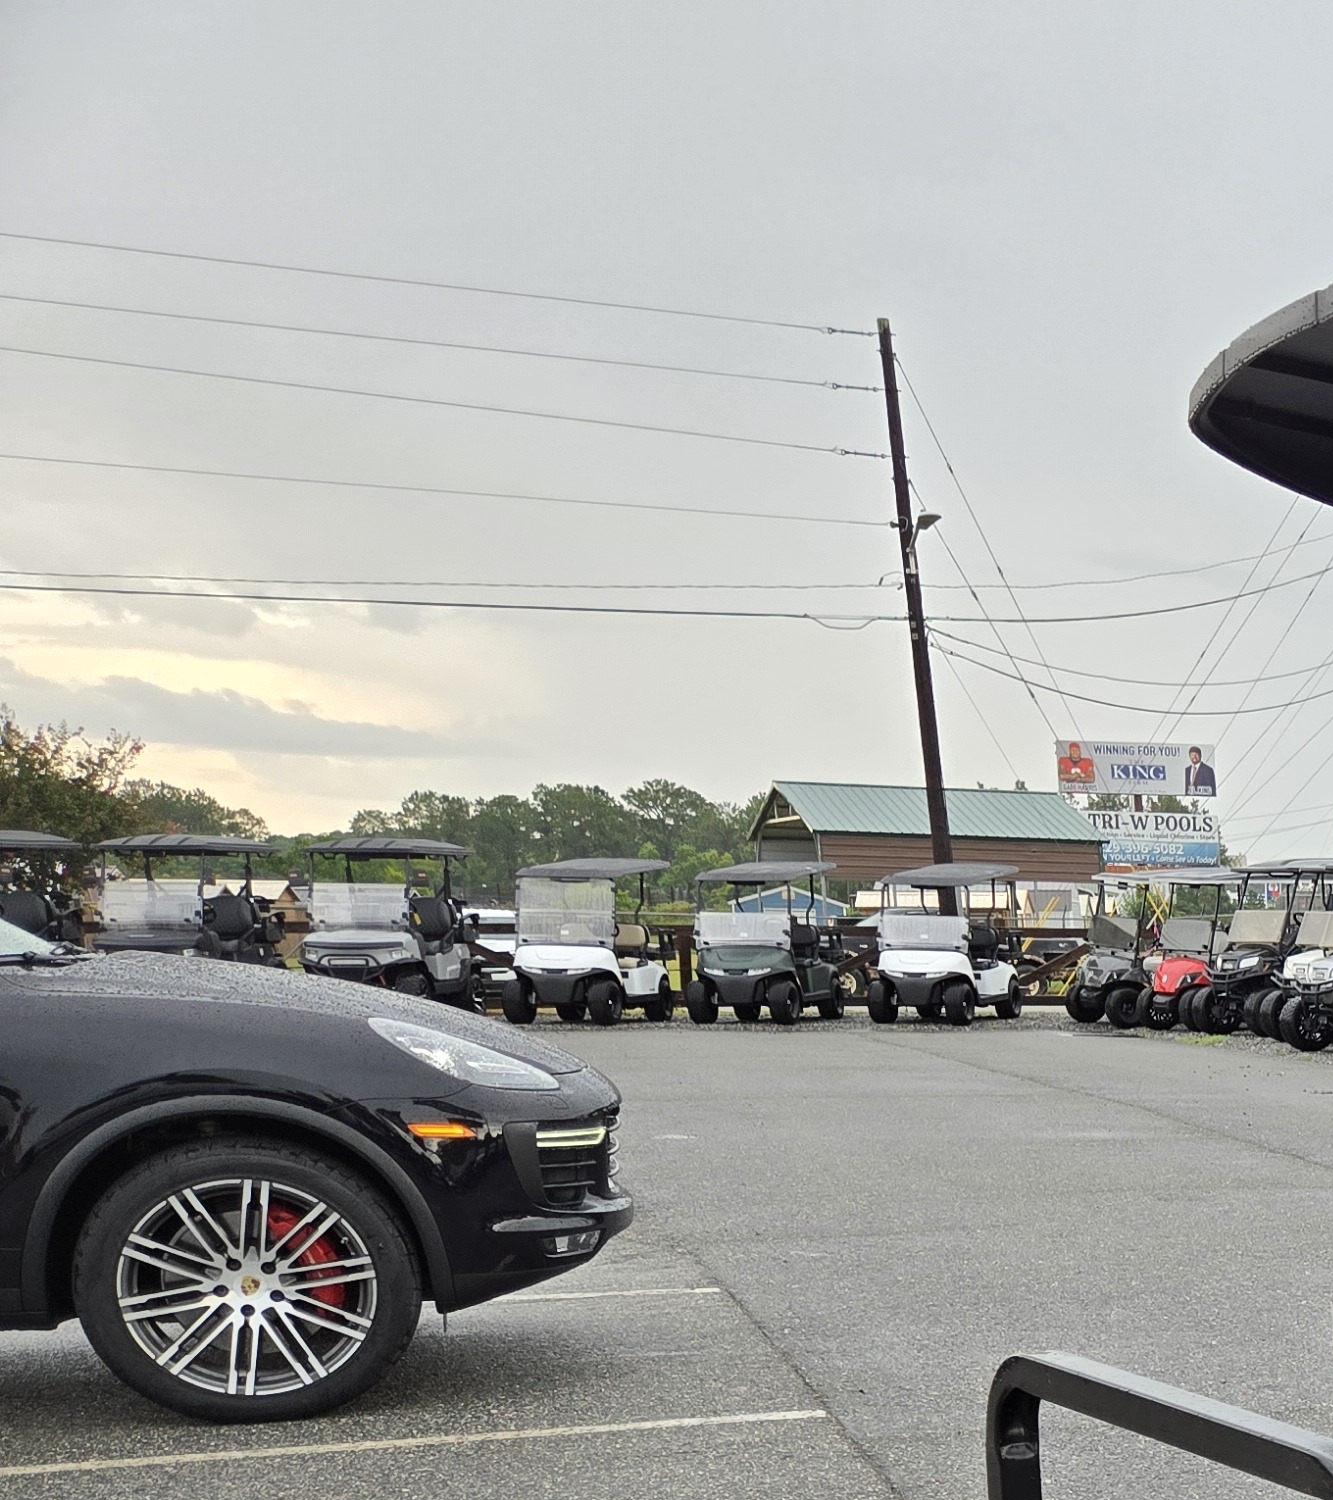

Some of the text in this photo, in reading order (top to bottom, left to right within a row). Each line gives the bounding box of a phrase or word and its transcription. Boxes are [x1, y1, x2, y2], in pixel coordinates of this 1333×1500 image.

[1093, 744, 1180, 757] WINNING FOR YOU!
[1113, 765, 1165, 779] KING
[1088, 813, 1213, 832] TRI-W POOLS
